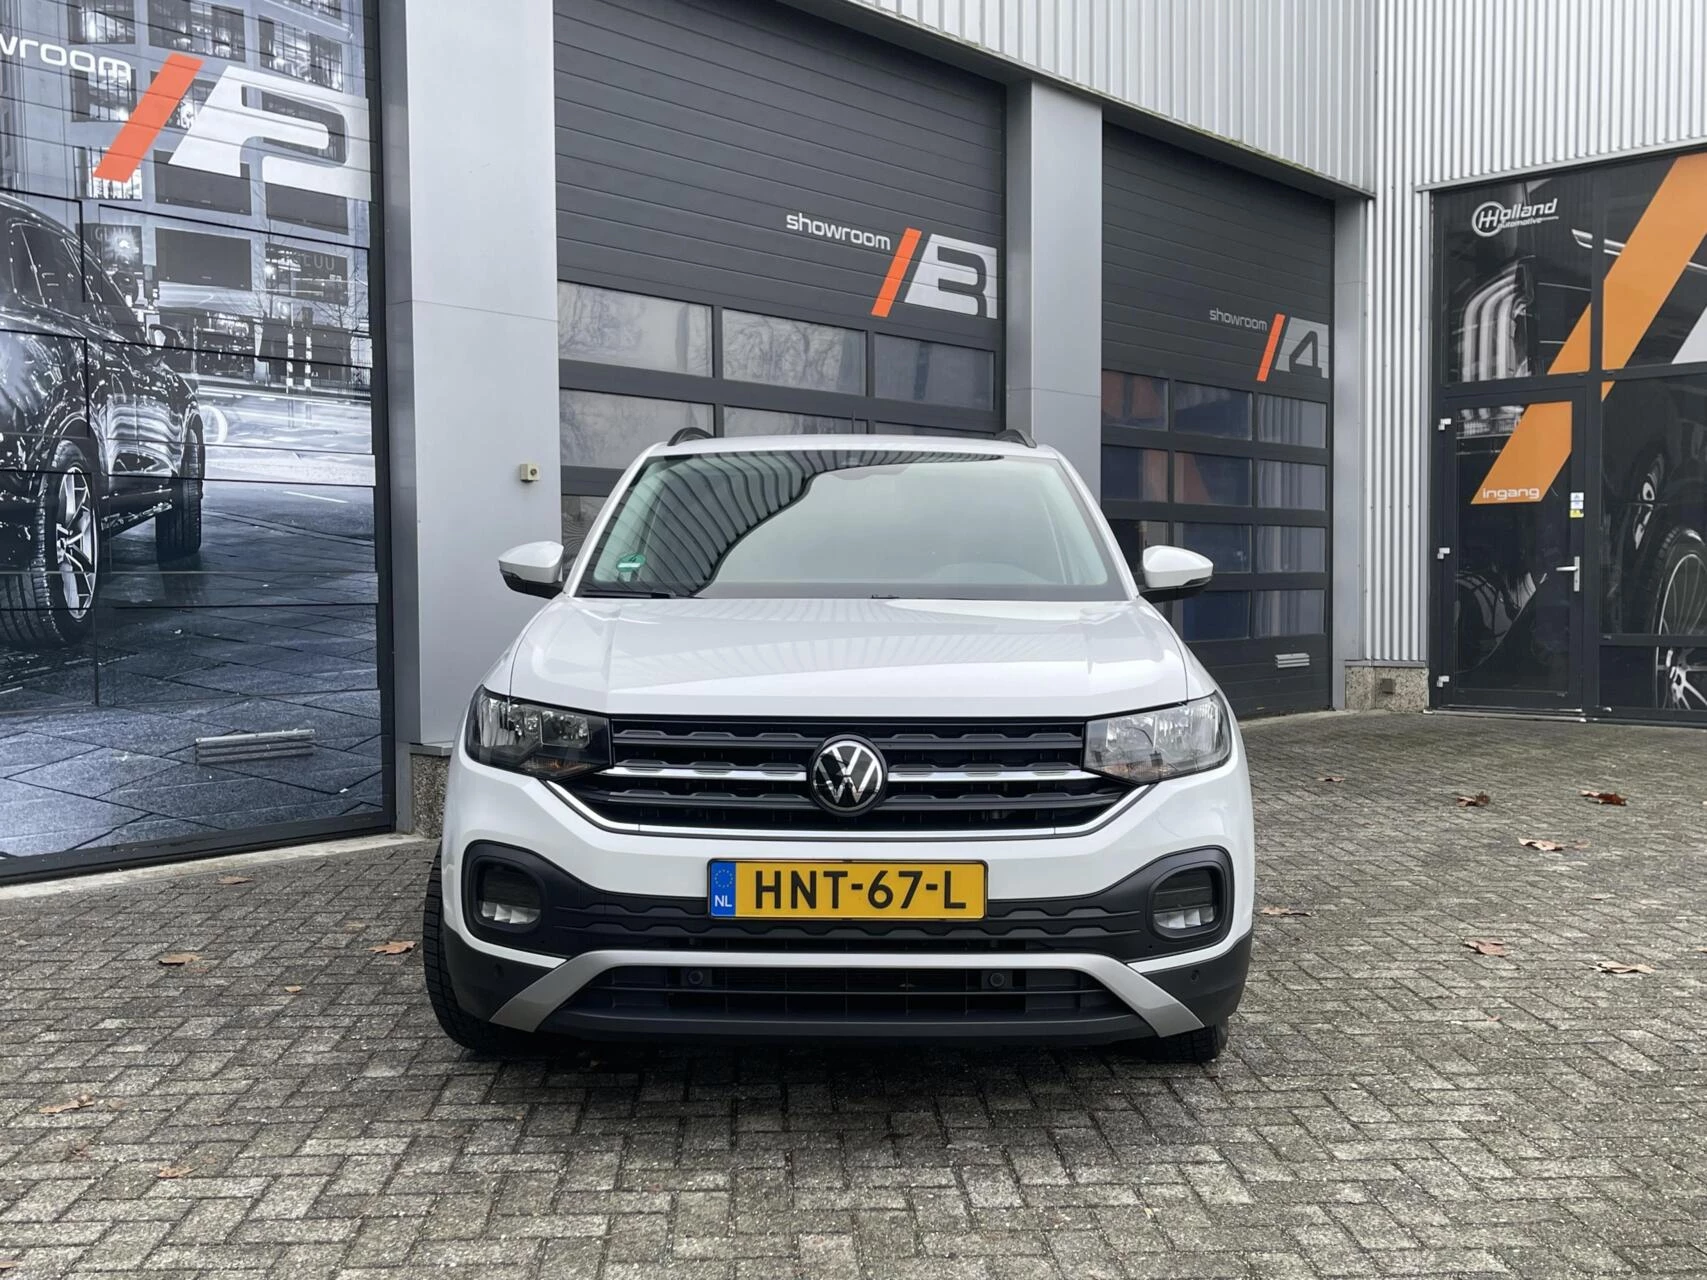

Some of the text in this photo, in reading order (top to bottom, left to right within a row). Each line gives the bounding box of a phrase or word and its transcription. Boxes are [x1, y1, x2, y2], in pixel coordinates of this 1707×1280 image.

[786, 213, 891, 250] showroom
[1209, 308, 1268, 331] showroom
[1482, 487, 1540, 500] ingang
[755, 870, 967, 909] HNT-67-L
[714, 895, 733, 908] NL
